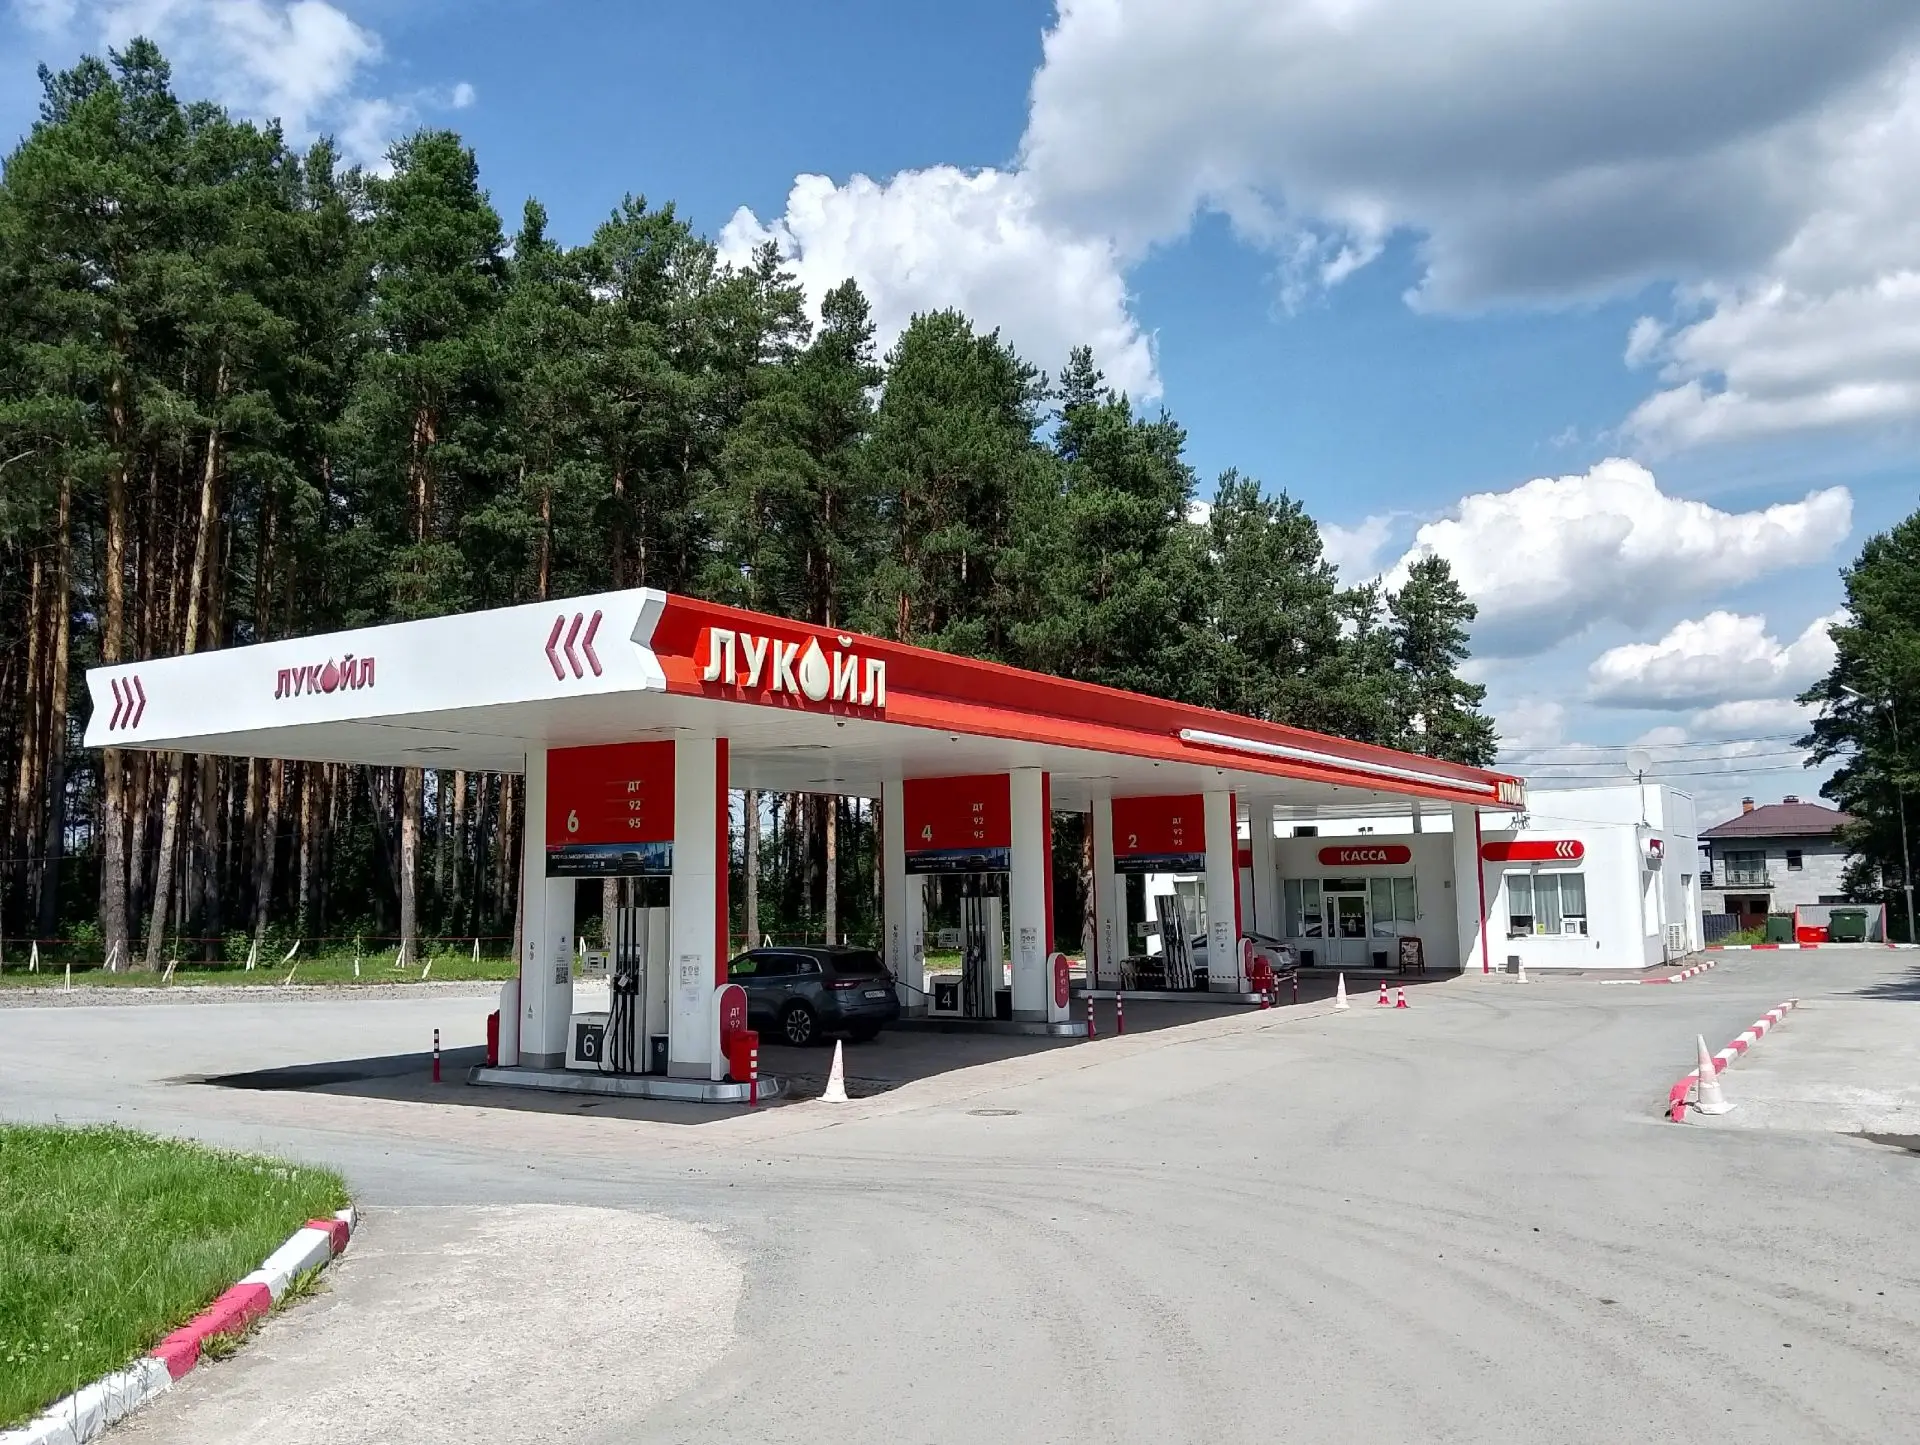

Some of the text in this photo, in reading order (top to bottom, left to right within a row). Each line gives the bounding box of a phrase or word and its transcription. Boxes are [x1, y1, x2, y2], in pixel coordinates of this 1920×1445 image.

[702, 626, 886, 708] ЛУКОЙЛ
[274, 652, 375, 700] ЛУКОЙЛ
[627, 780, 641, 793] ДТ
[628, 800, 641, 811] 92
[972, 802, 984, 812] ДТ
[566, 809, 579, 833] 6
[628, 818, 641, 829] 95
[973, 816, 984, 825] 92
[921, 824, 933, 842] 4
[973, 830, 984, 839] 95
[1128, 834, 1138, 848] 2
[1340, 849, 1387, 862] КАССА
[941, 990, 952, 1008] 4
[730, 1007, 740, 1018] ДТ
[583, 1033, 595, 1057] 6
